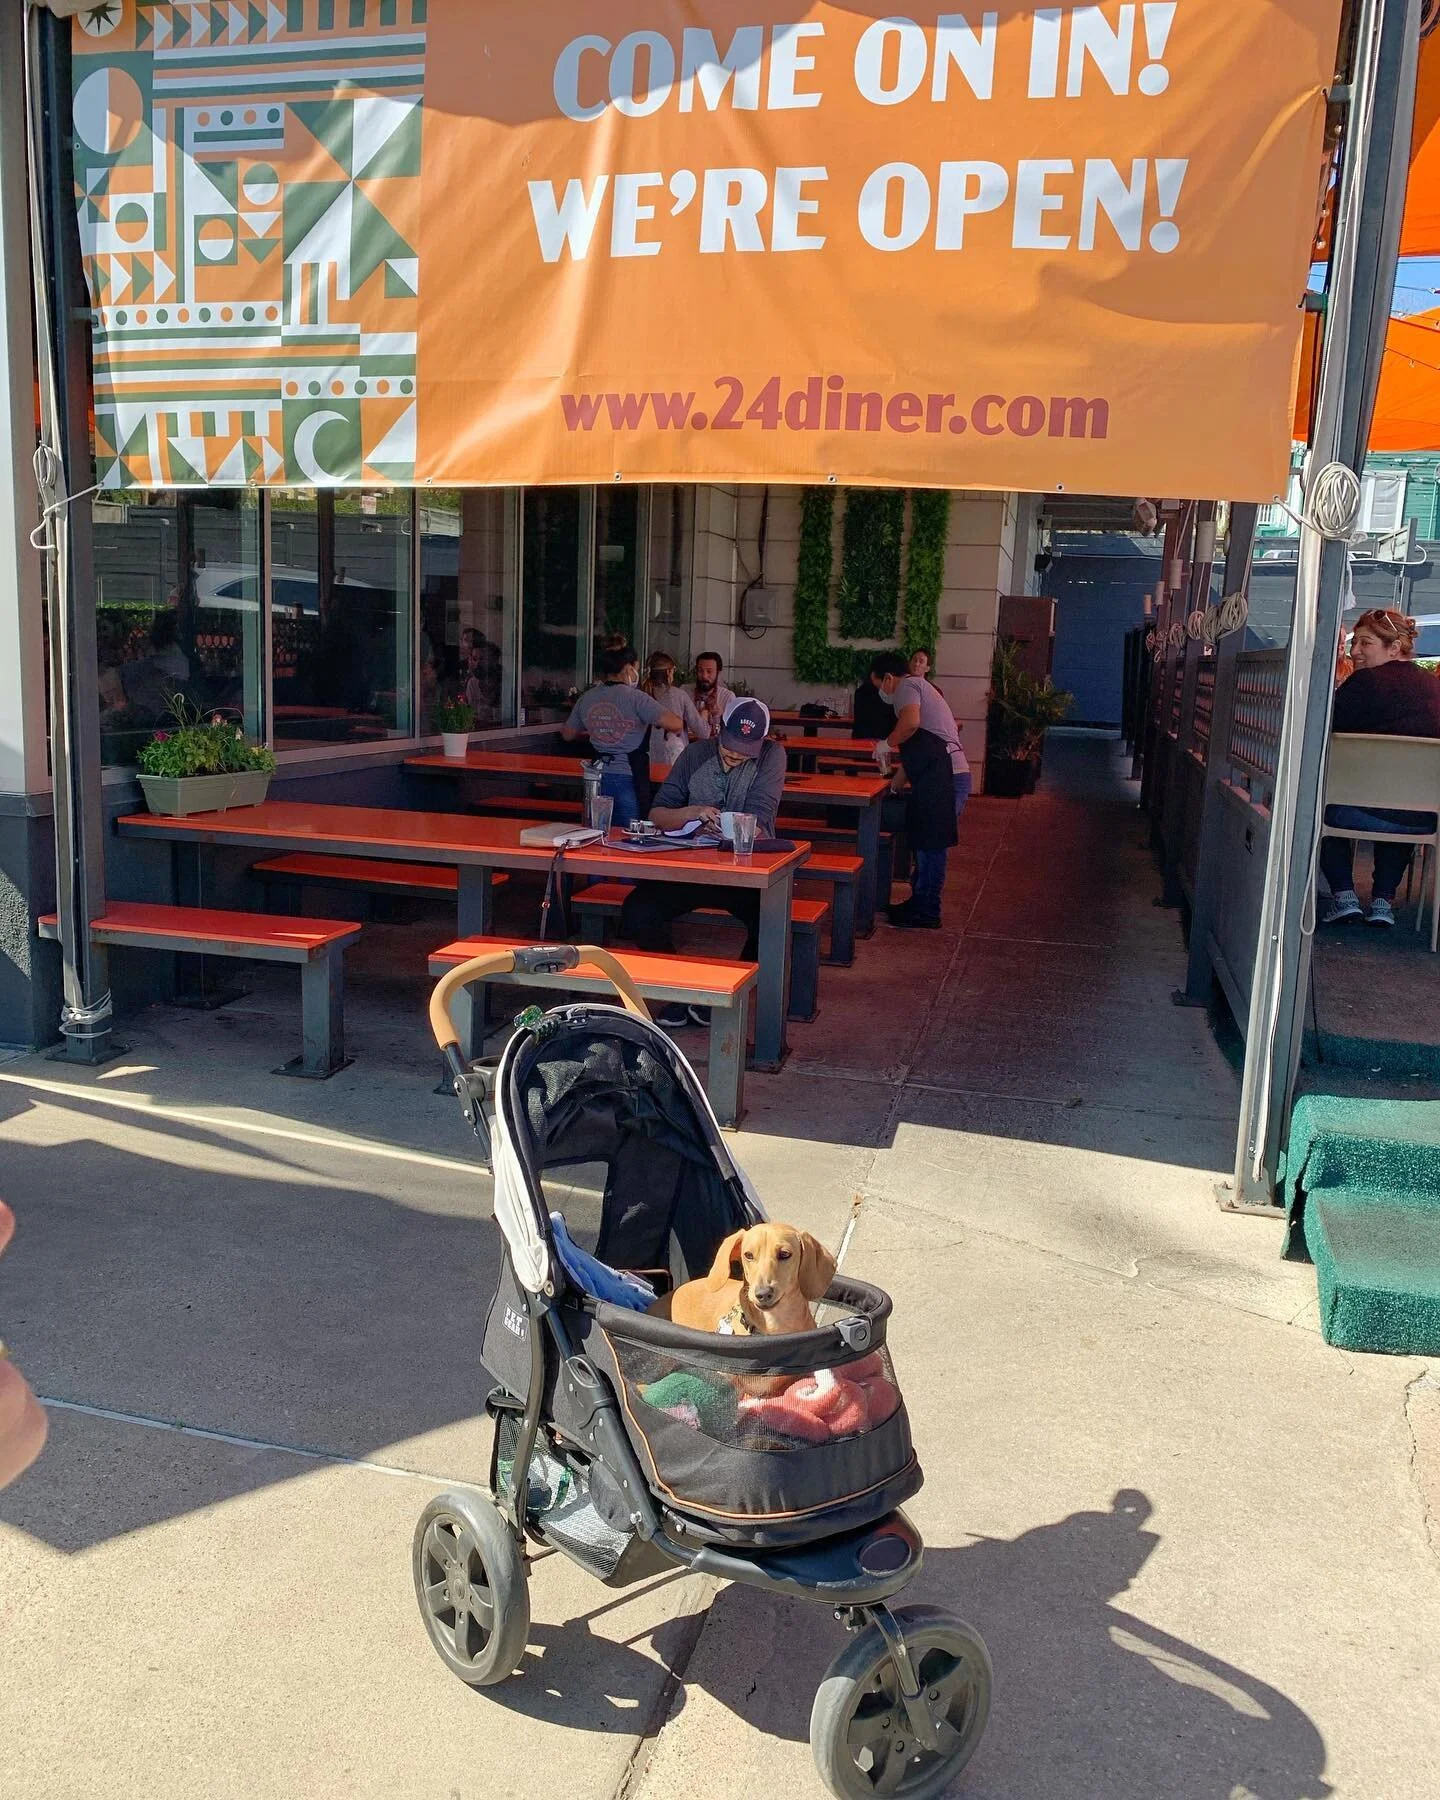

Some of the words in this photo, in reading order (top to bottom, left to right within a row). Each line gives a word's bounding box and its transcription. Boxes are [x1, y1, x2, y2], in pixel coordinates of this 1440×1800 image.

[553, 22, 825, 122] COME
[854, 11, 998, 105] ON
[1027, 2, 1177, 98] IN!
[527, 166, 829, 263] WE'RE
[858, 158, 1189, 253] OPEN!
[560, 375, 1109, 439] www.24diner.com
[506, 1306, 523, 1327] PET
